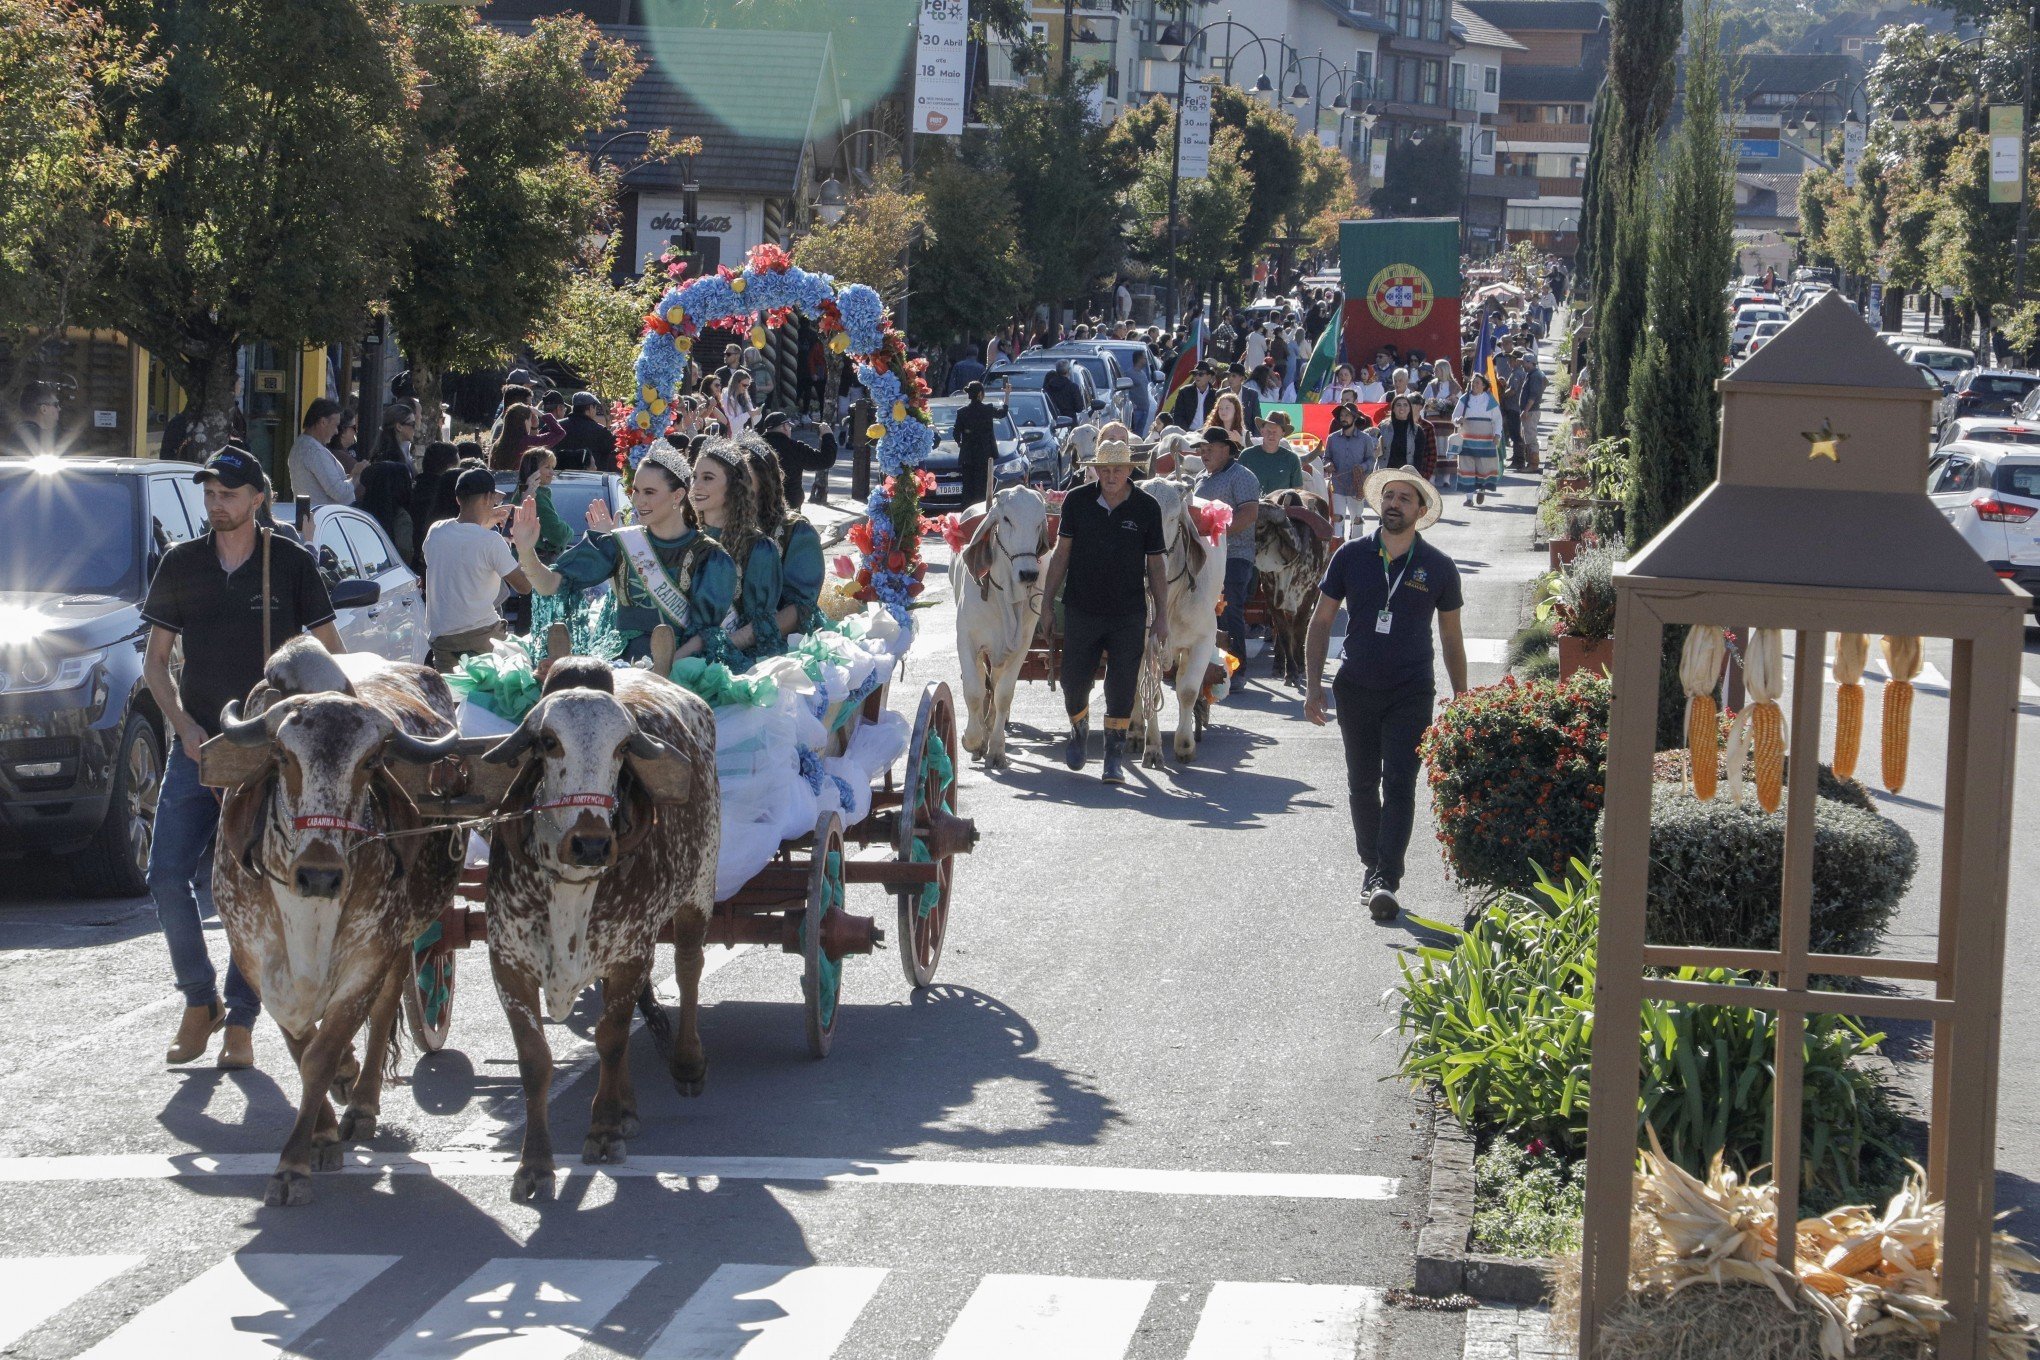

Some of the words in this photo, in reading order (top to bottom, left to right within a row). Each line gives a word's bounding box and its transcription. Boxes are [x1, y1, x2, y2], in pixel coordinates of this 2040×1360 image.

[923, 34, 940, 46] 30
[943, 39, 963, 47] Abril
[921, 64, 936, 77] 18
[940, 69, 961, 78] Maio
[1183, 136, 1192, 145] 18
[653, 581, 691, 619] RAINHA
[306, 816, 335, 827] CABANHA
